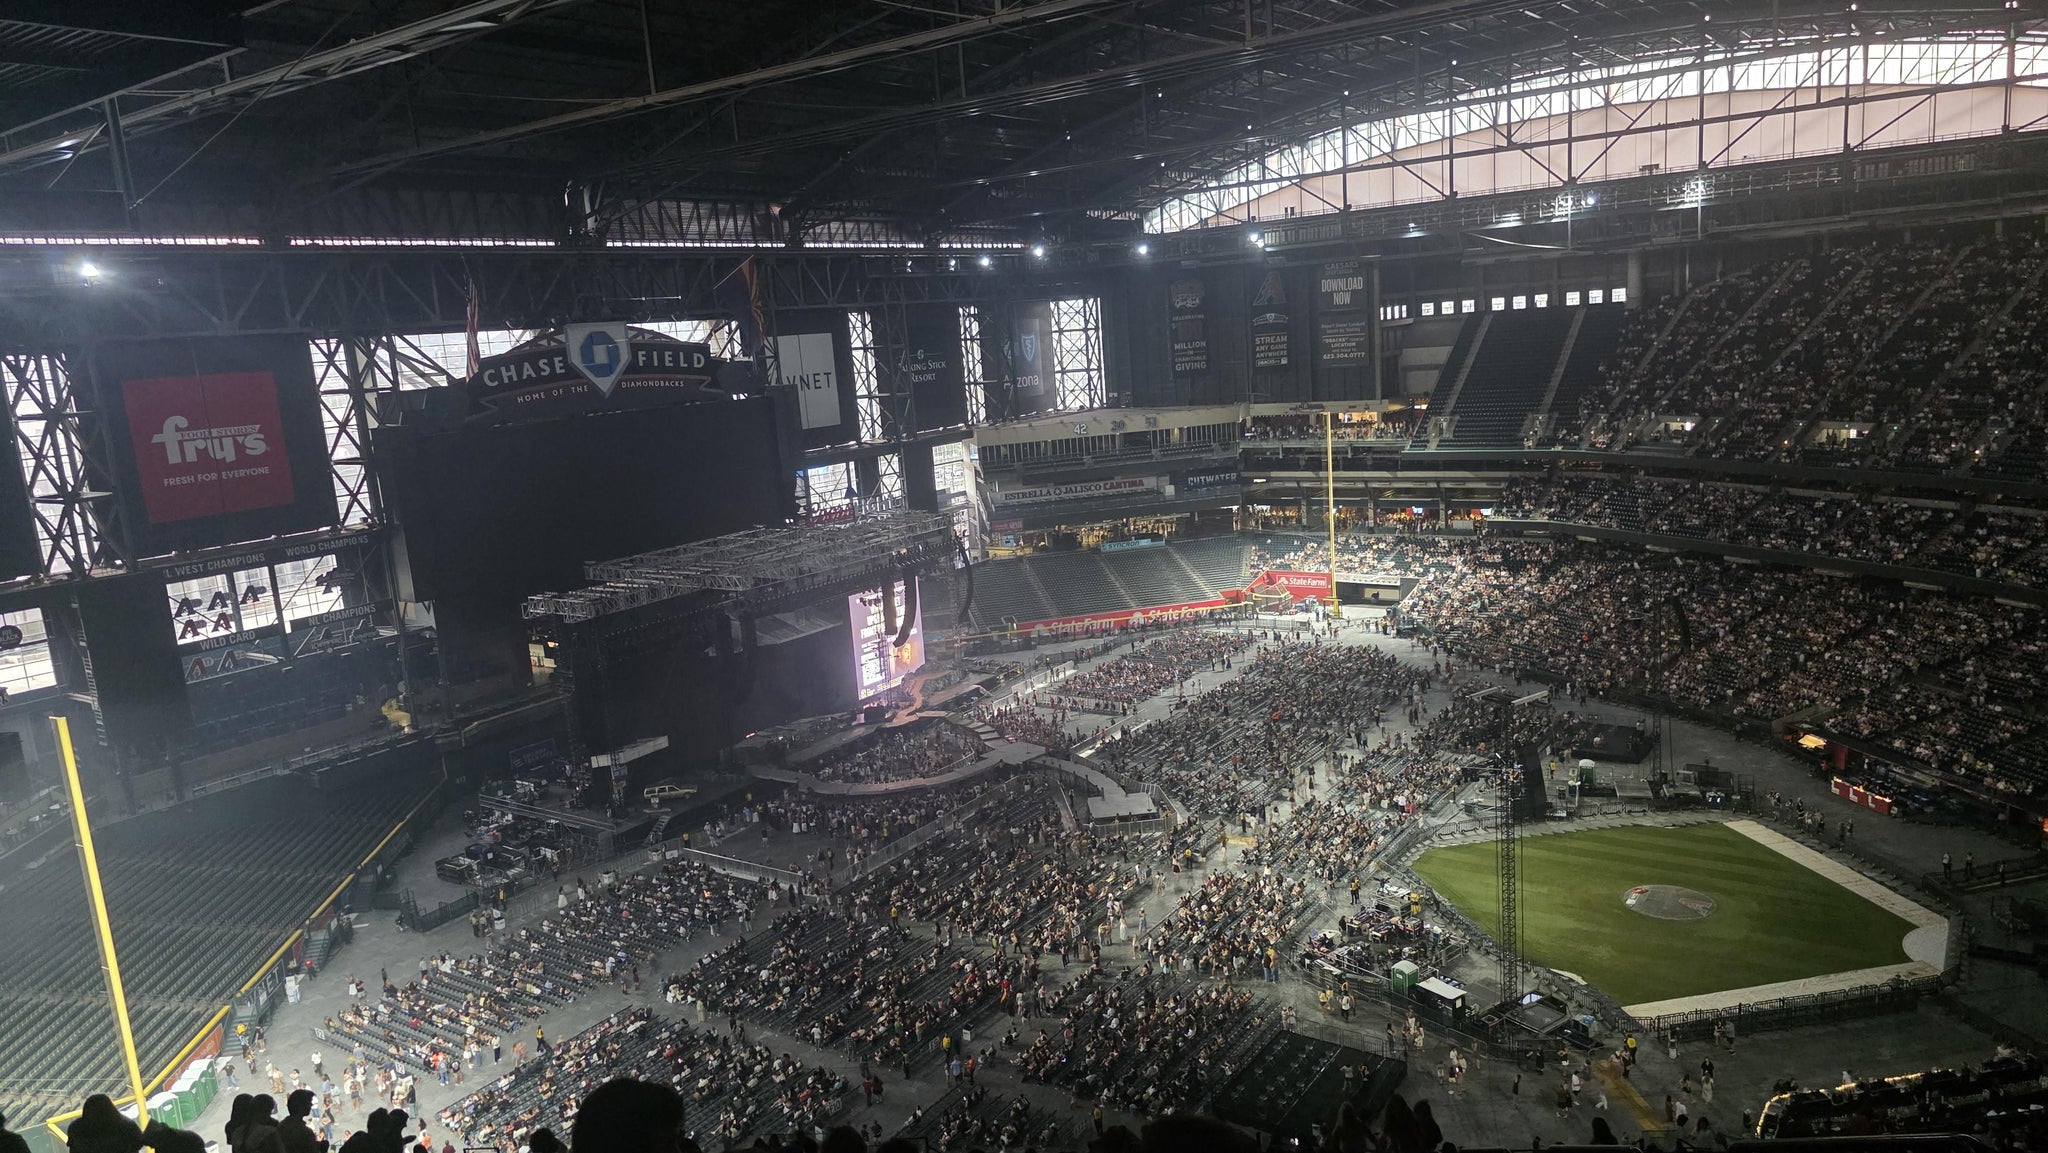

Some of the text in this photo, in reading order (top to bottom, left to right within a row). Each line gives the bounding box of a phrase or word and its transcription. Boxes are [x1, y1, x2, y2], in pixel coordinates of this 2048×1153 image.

[1324, 261, 1359, 271] CAESARS
[1321, 276, 1363, 292] DOWNLOAD
[1333, 292, 1351, 306] NOW
[1174, 341, 1206, 351] MILLION
[1255, 336, 1288, 345] STREAM
[1174, 355, 1206, 363] CHARITABLE
[1255, 350, 1288, 359] ANYWHERE
[483, 350, 705, 387] CHASE FIELD
[1175, 361, 1207, 372] GIVING
[517, 391, 546, 404] HOME
[552, 388, 565, 397] OF
[571, 384, 588, 394] THE
[180, 425, 257, 440] FOOD STORES
[1073, 423, 1087, 434] 42
[1111, 419, 1125, 431] 20
[151, 415, 267, 464] fry's
[163, 466, 270, 487] FRESH FOR EVERYONE
[1188, 473, 1237, 486] CUTWATER
[1004, 479, 1144, 501] ESTRELLA JALISCO CANTINA
[285, 535, 369, 557] WORLD CHAMPIONS
[175, 563, 204, 576] WEST
[207, 553, 265, 571] CHAMPIONS
[308, 604, 376, 627] NL CHAMPIONS
[200, 630, 256, 651] WILD CARD
